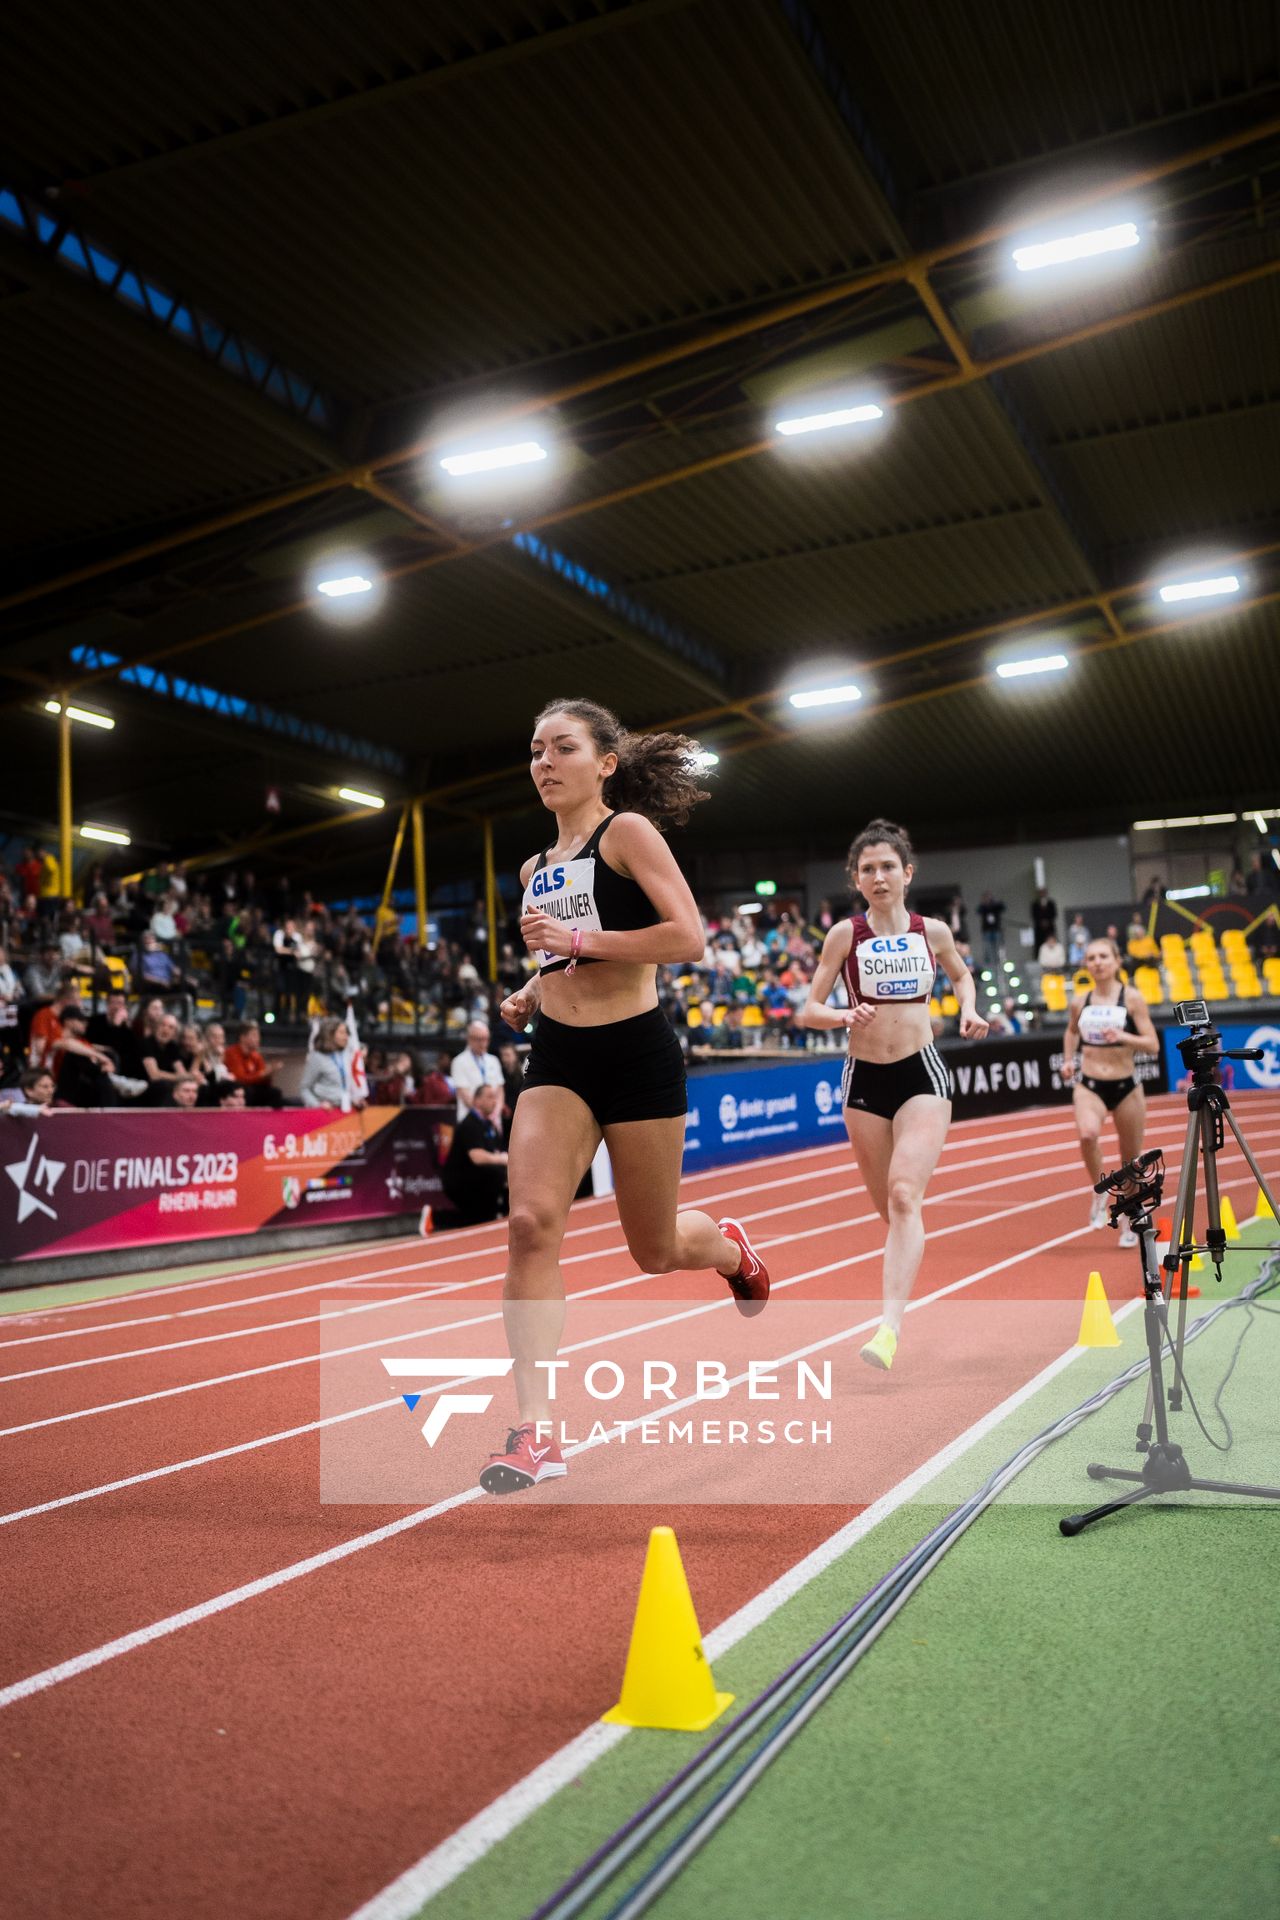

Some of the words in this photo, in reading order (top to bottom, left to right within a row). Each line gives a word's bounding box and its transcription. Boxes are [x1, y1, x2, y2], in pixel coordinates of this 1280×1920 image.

[864, 957, 928, 975] SCHMITZ
[894, 982, 917, 990] PLAN
[302, 1132, 328, 1157] Juli
[73, 1158, 110, 1194] DIE
[113, 1154, 190, 1190] FINALS
[191, 1152, 238, 1184] 2023
[158, 1188, 237, 1212] RHEIN-RUHR
